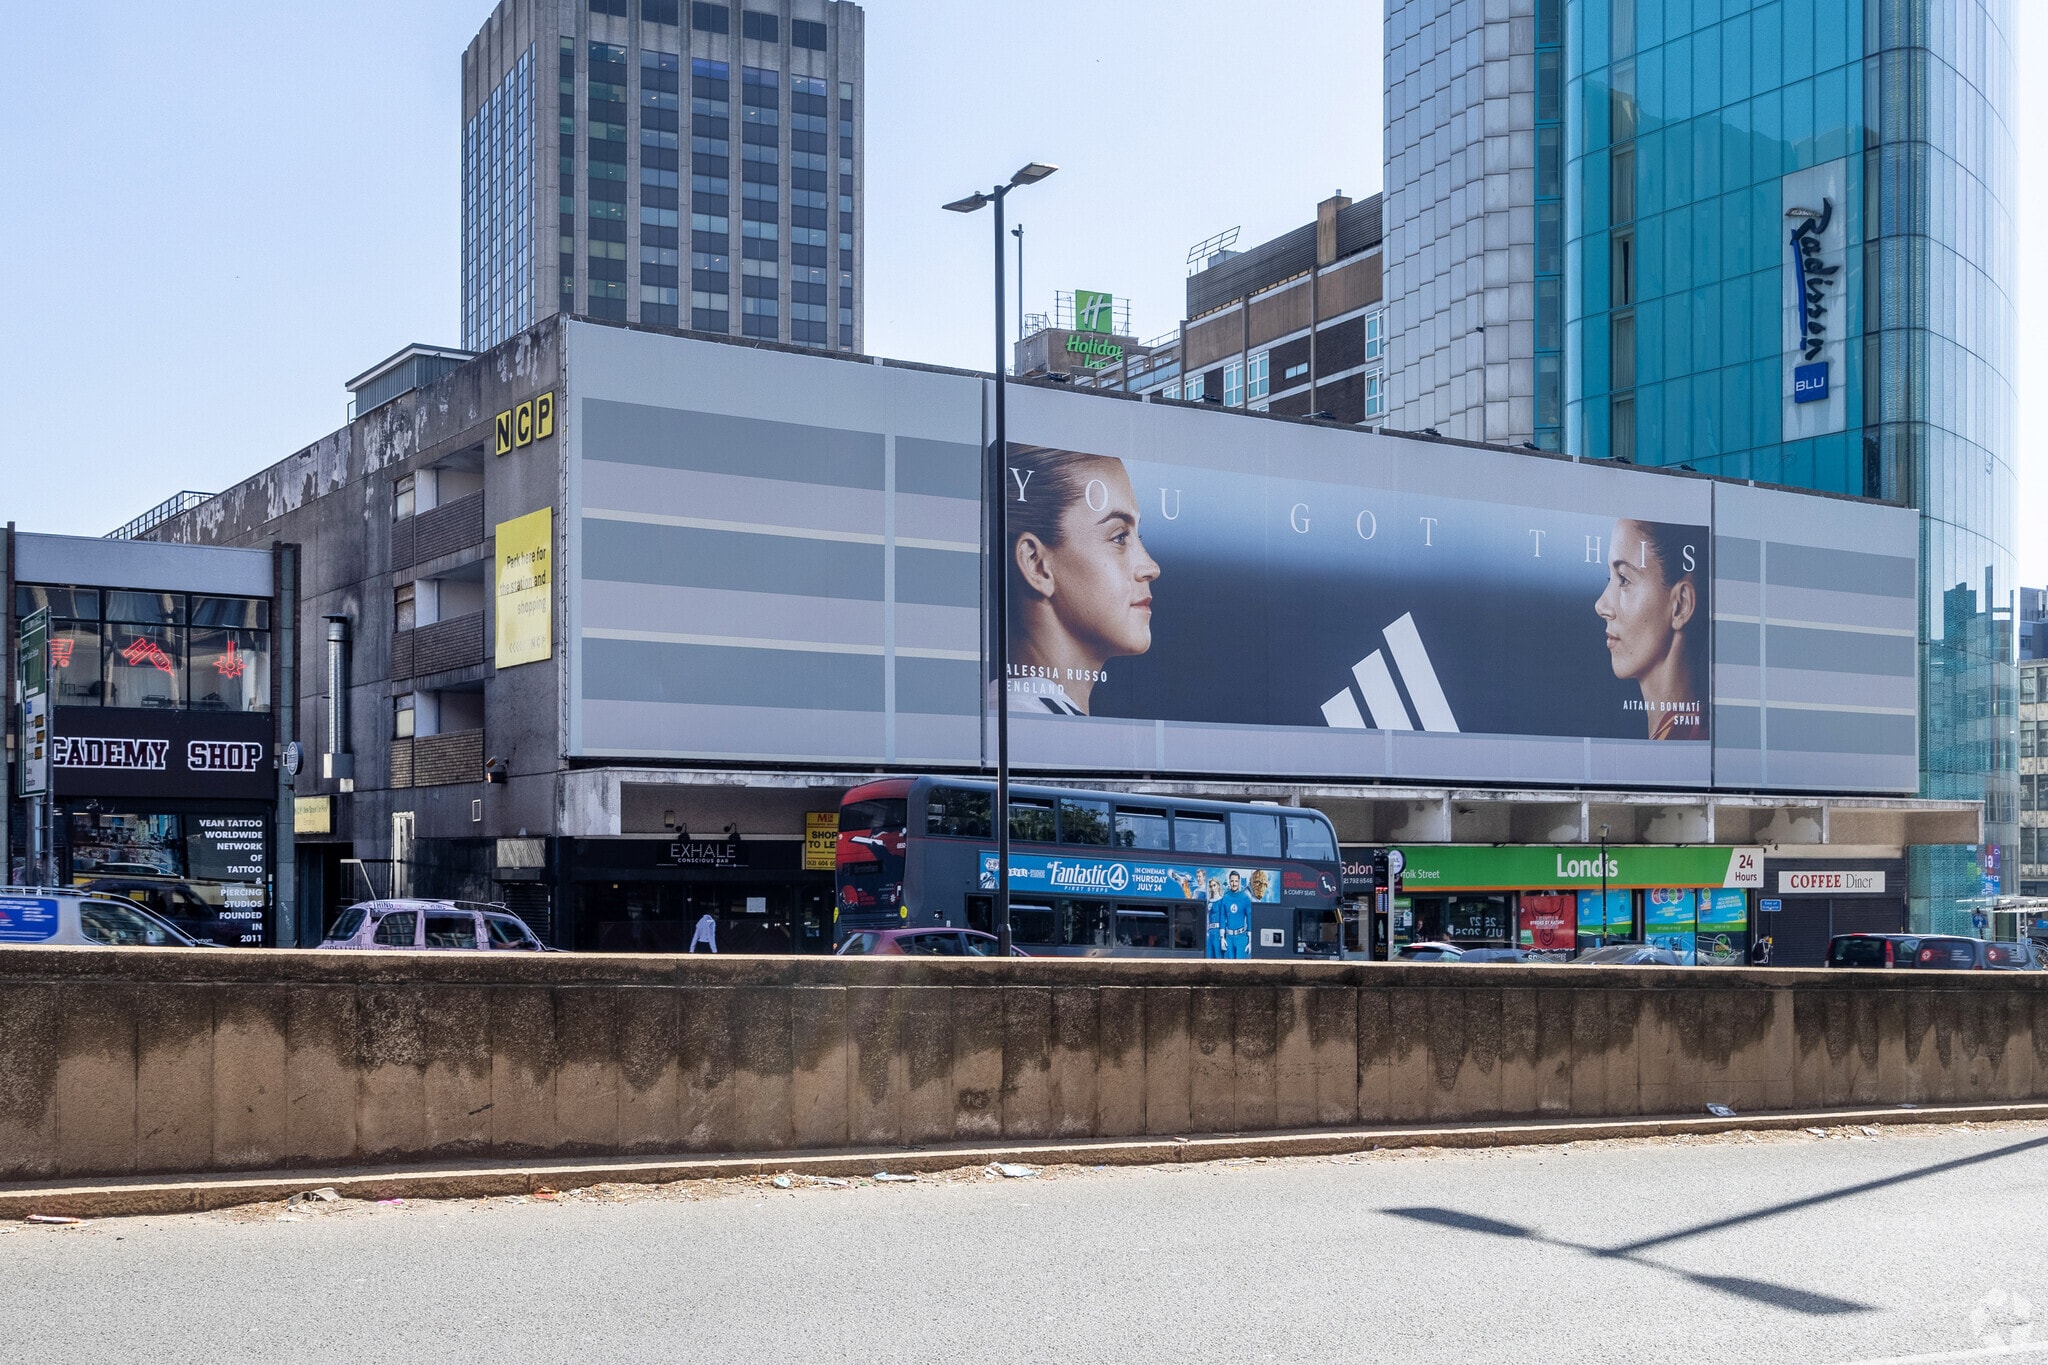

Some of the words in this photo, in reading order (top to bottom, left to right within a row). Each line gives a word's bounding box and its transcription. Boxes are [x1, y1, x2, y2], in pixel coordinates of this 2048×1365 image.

[1785, 198, 1840, 361] Radisson
[1066, 334, 1124, 361] Holiday
[1795, 376, 1825, 392] BLU
[496, 394, 552, 453] NCP
[1009, 466, 1182, 521] YOU
[1289, 502, 1438, 547] GOT
[1528, 529, 1697, 572] THIS
[506, 554, 520, 569] Park
[521, 550, 536, 565] here
[536, 546, 547, 561] for
[510, 575, 533, 592] station
[533, 570, 546, 586] and
[517, 596, 547, 617] shopping
[1006, 663, 1050, 680] ALESSIA
[1066, 668, 1108, 683] RUSSO
[1006, 680, 1065, 696] ENGLAND
[1622, 700, 1656, 711] AITANA
[1660, 700, 1700, 712] BONMATÍ
[1673, 715, 1700, 726] SPAIN
[53, 736, 170, 770] CADEMY
[187, 740, 263, 772] SHOP
[199, 819, 224, 827] VEAN
[227, 819, 263, 828] TATTOO
[204, 831, 263, 839] WORLDWIDE
[811, 830, 838, 839] SHOP
[216, 842, 263, 850] NETWORK
[670, 843, 736, 858] EXHALE
[808, 841, 821, 849] TO
[823, 841, 837, 849] LE
[250, 854, 263, 862] OF
[1737, 854, 1755, 869] 24
[1341, 861, 1373, 875] Salon
[1556, 853, 1619, 878] Londis
[1050, 861, 1109, 886] Fantastic
[1108, 864, 1127, 889] 4
[1132, 874, 1168, 884] THURSDAY
[1417, 869, 1440, 879] Street
[1735, 871, 1757, 882] Hours
[255, 877, 262, 885] &
[1790, 874, 1842, 888] COFFEE
[1846, 873, 1873, 889] Diner
[220, 889, 263, 897] PIERCING
[1137, 883, 1153, 891] JULY
[1153, 884, 1162, 892] 24
[224, 900, 263, 908] STUDIOS
[219, 912, 263, 920] FOUNDED
[251, 923, 262, 931] IN
[240, 935, 262, 943] 2011
